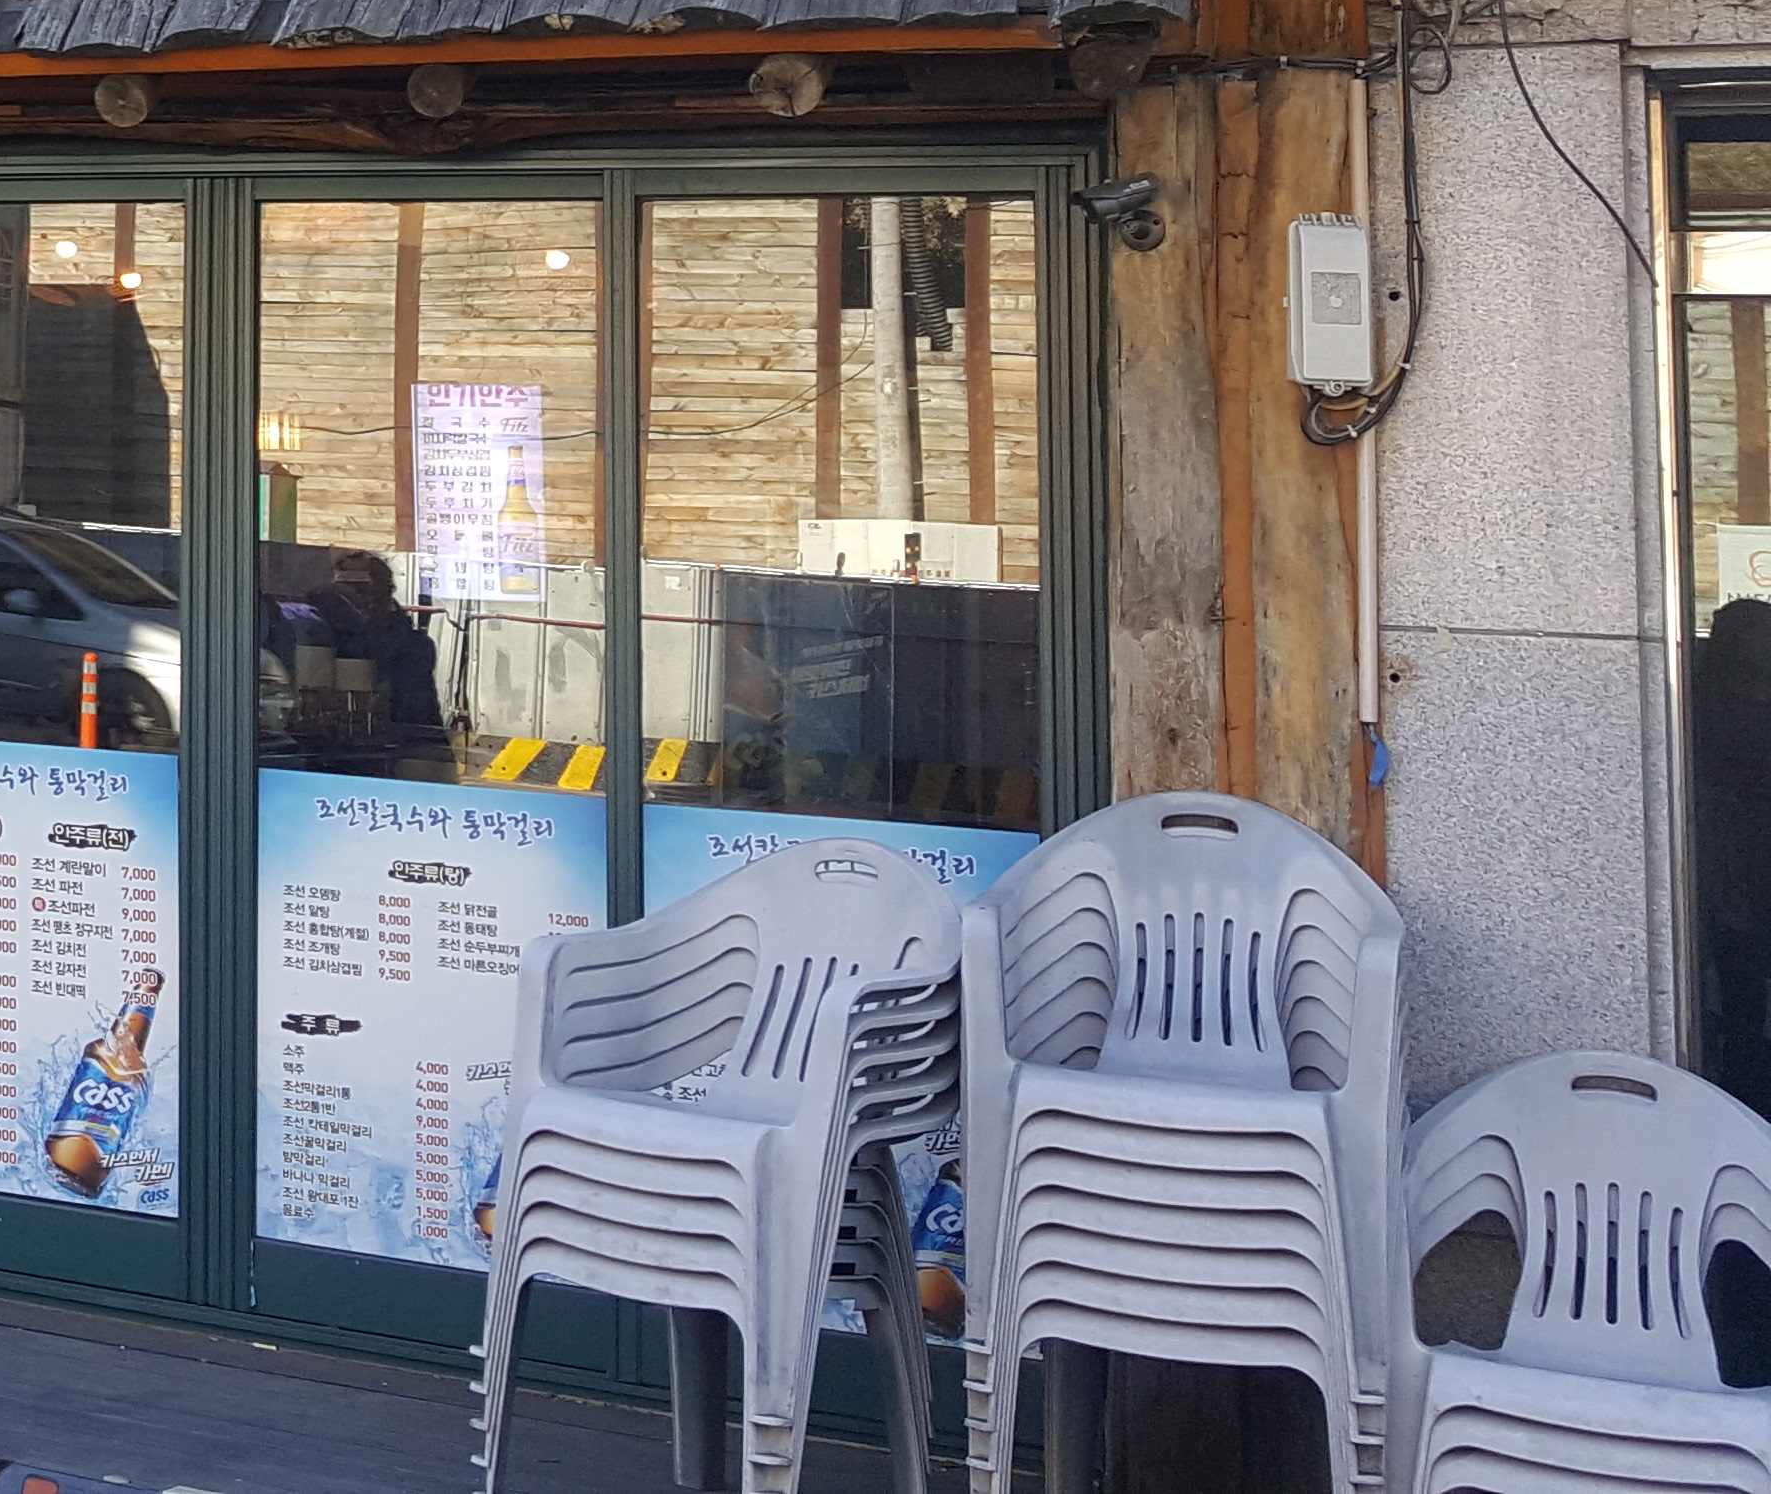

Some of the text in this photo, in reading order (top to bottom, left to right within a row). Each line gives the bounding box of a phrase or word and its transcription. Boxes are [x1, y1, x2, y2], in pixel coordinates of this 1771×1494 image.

[48, 768, 129, 801] 통막걸리
[316, 798, 555, 846] 조선칼국수와 통막걸리
[54, 823, 130, 848] 안주류(전)
[31, 857, 156, 881] 조선 계란말이 7,000
[31, 877, 156, 902] 조선 파전 7,000
[283, 884, 305, 898] 조선
[378, 895, 411, 909] 8,000
[282, 1045, 305, 1057] 소주
[415, 1061, 449, 1075] 4,000
